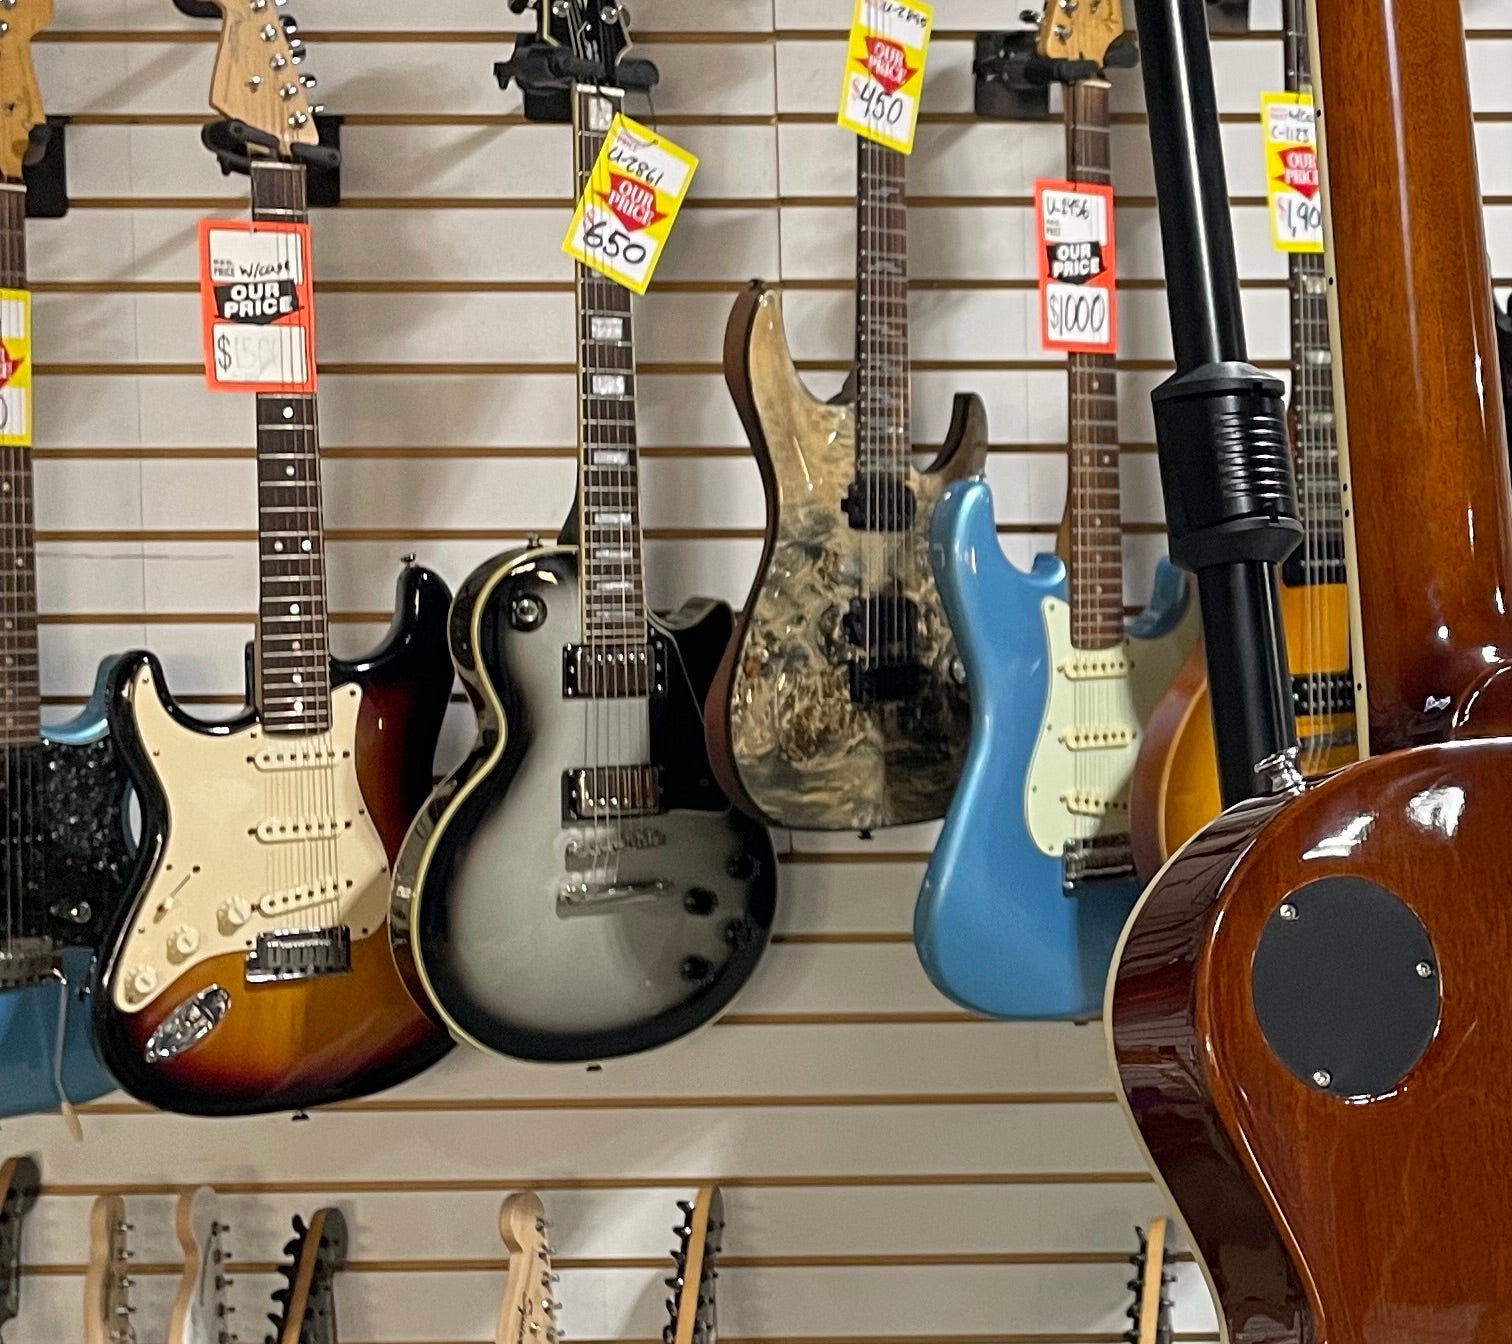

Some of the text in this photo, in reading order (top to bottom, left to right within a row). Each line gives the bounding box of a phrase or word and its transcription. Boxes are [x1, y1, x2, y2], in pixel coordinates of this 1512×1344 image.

[874, 41, 905, 64] OUR
[868, 55, 909, 84] PRICE
[618, 180, 655, 209] OUR
[608, 189, 656, 228] PRICE
[1056, 243, 1092, 262] OUR
[1051, 256, 1101, 279] PRICE
[230, 281, 281, 303] OUR
[223, 295, 294, 320] PRICE
[1049, 292, 1106, 337] $1000
